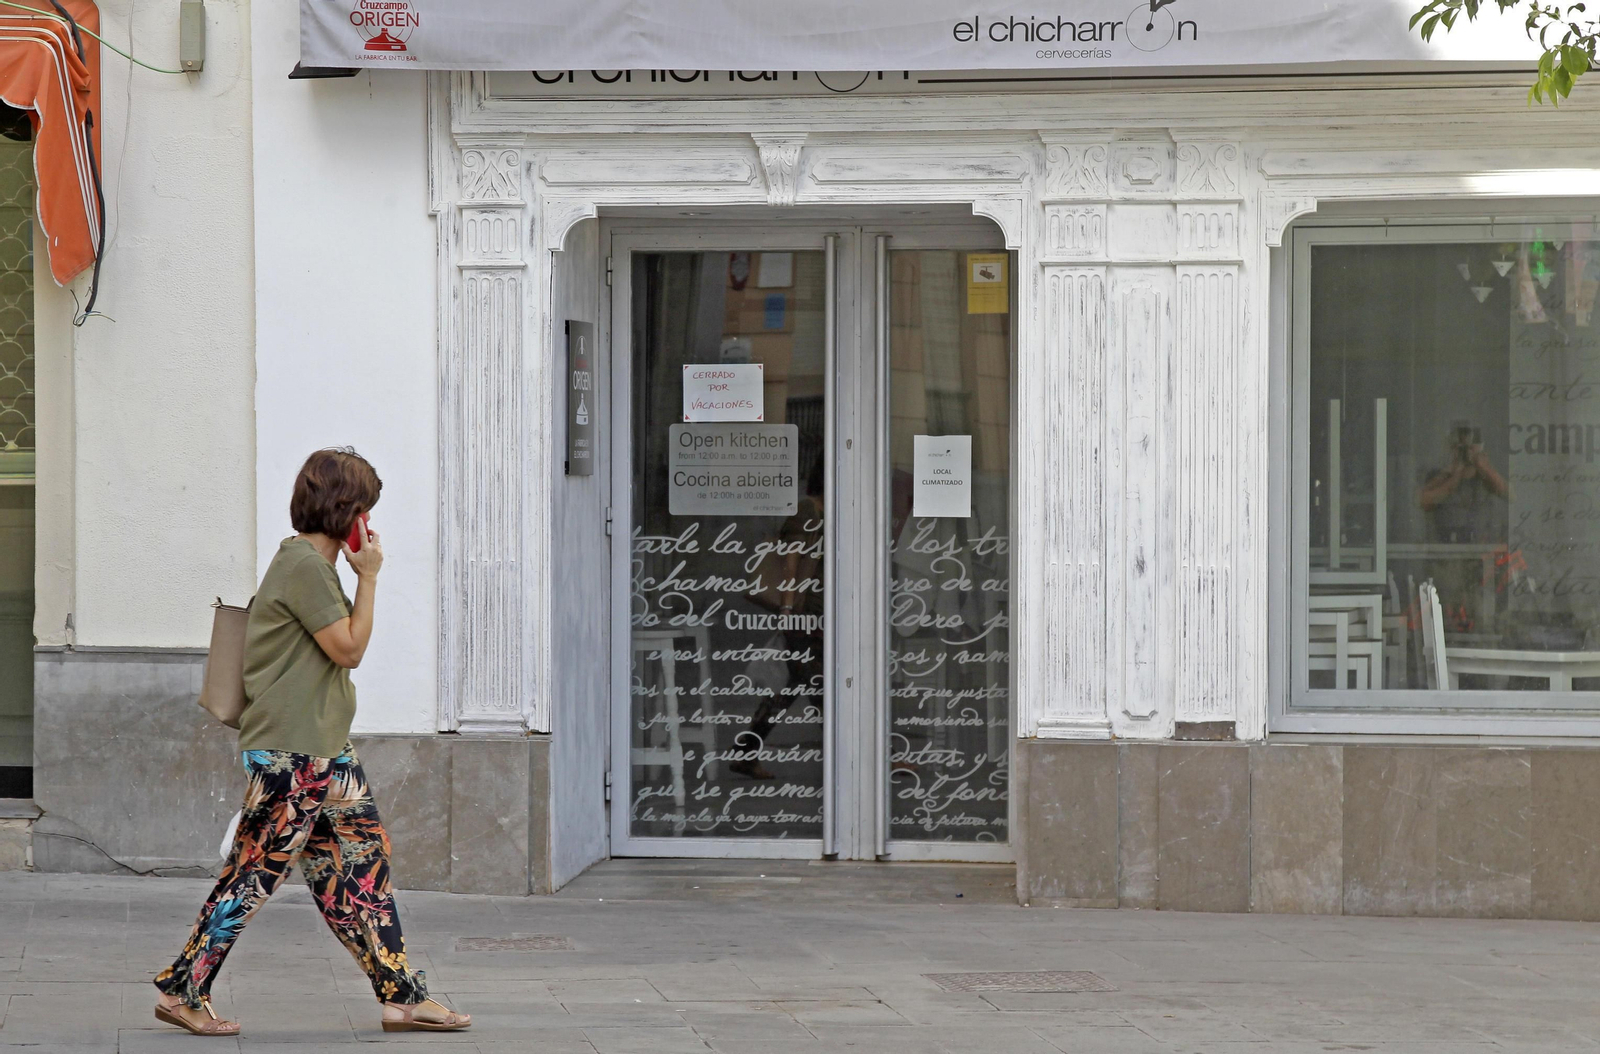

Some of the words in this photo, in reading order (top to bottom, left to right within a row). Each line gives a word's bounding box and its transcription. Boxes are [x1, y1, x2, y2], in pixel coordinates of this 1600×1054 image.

[360, 0, 408, 11] Cruzcampo
[349, 11, 420, 27] ORIGEN
[953, 16, 979, 42] el
[1036, 47, 1112, 59] cervecerías
[692, 371, 735, 380] CERRADO
[708, 384, 730, 392] POR
[691, 398, 754, 410] VACACIONES
[679, 432, 723, 450] Open
[730, 432, 788, 448] kitchen
[678, 452, 696, 460] from
[698, 452, 719, 460] 12:00
[740, 452, 748, 460] to
[750, 452, 771, 460] 12:00
[674, 471, 731, 488] Cocina
[736, 471, 794, 488] abierta
[709, 491, 735, 500] 12:00h
[744, 491, 770, 500] 00:00h
[708, 522, 747, 553] la
[659, 592, 724, 627] del
[712, 643, 815, 664] entonces
[689, 678, 712, 696] el
[918, 687, 954, 709] que
[768, 708, 788, 725] el
[690, 781, 722, 800] se
